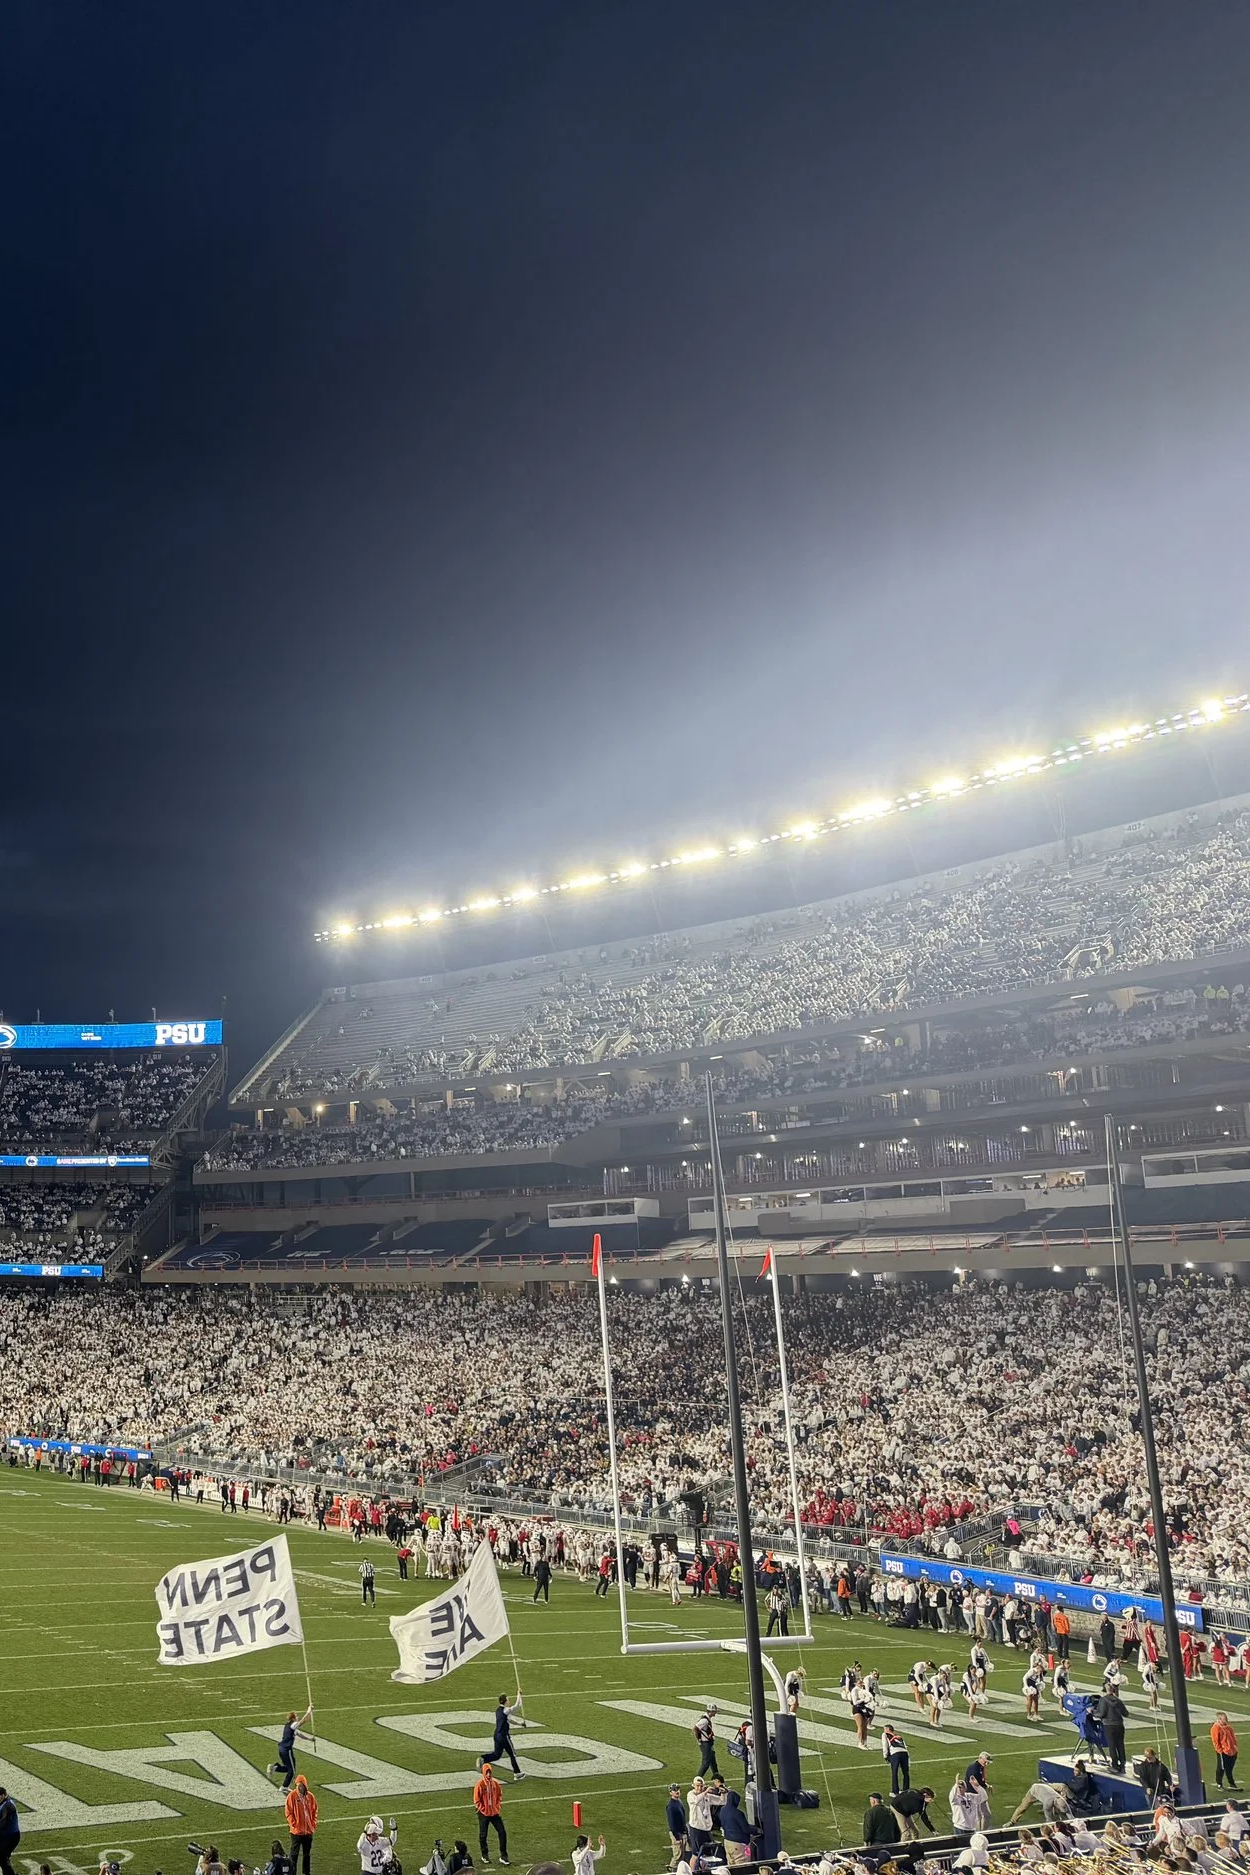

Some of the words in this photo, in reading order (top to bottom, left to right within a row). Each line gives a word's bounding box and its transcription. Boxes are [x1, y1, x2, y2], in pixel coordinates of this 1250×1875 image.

[155, 1023, 206, 1044] PSU
[42, 1265, 62, 1276] PSU
[885, 1559, 904, 1574] PSU
[1014, 1582, 1036, 1597] PSU
[371, 1851, 383, 1867] 22
